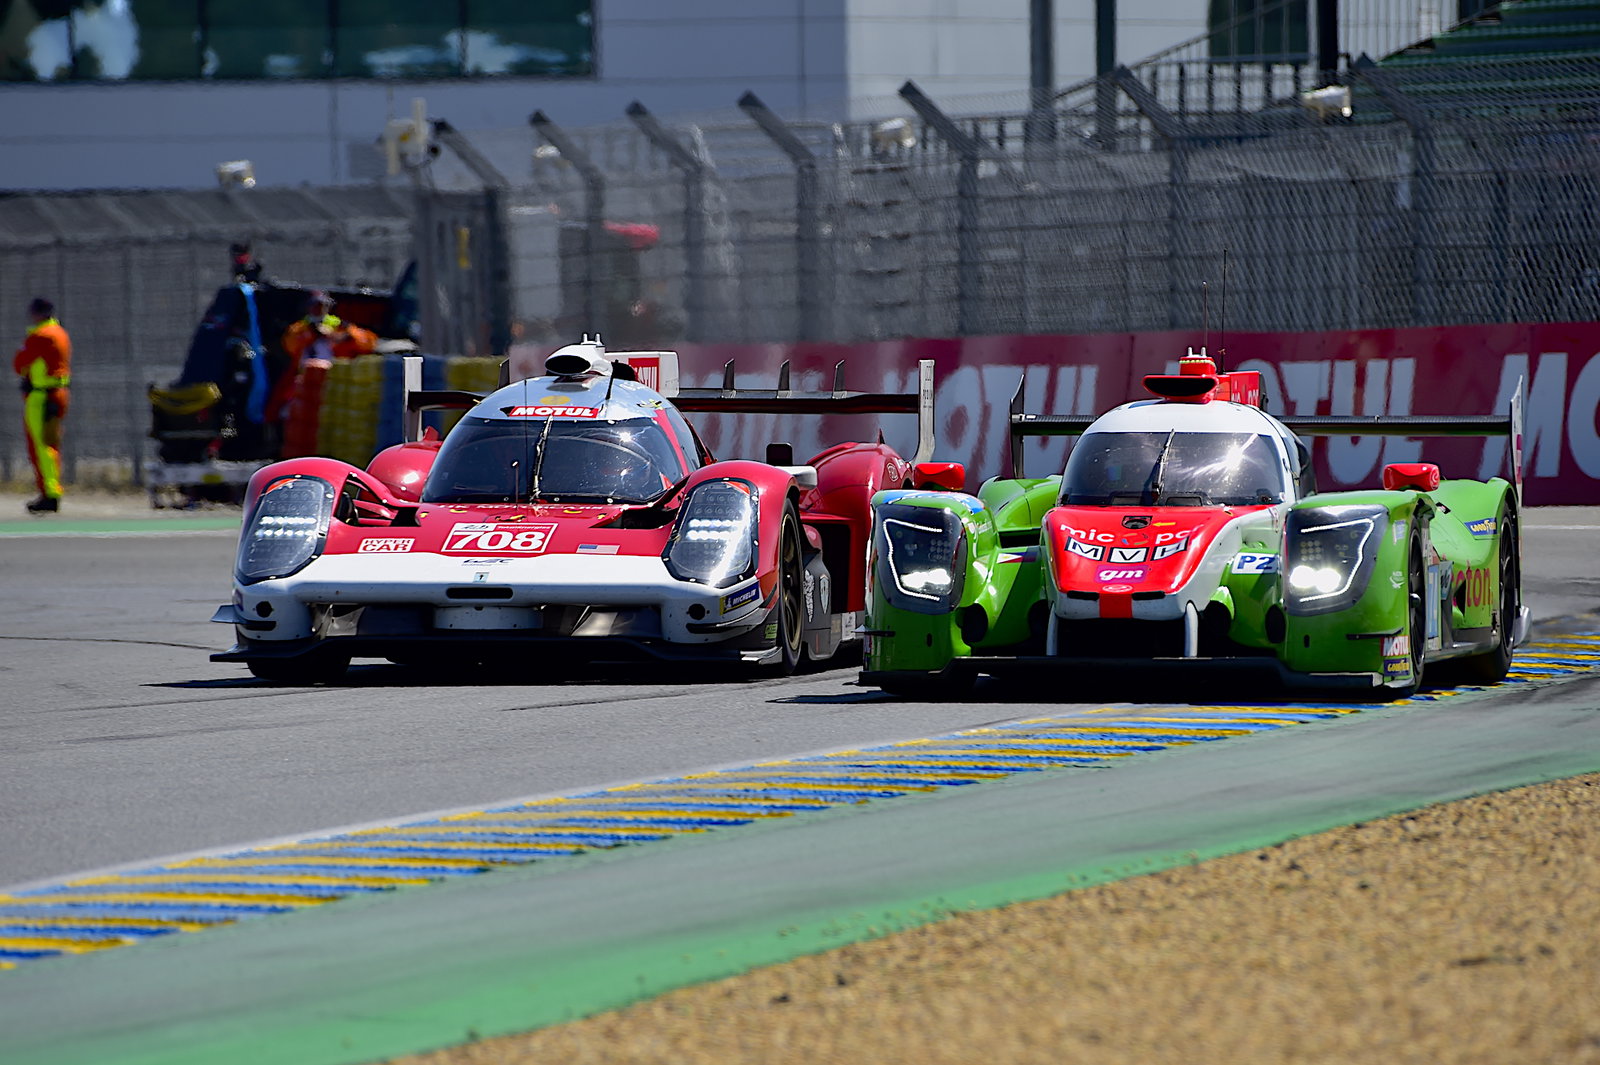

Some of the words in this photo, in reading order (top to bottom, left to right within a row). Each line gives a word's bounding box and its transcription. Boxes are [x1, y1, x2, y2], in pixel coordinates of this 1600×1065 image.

[511, 407, 594, 416] MOTUL
[451, 531, 546, 551] 708
[1237, 555, 1274, 570] P2
